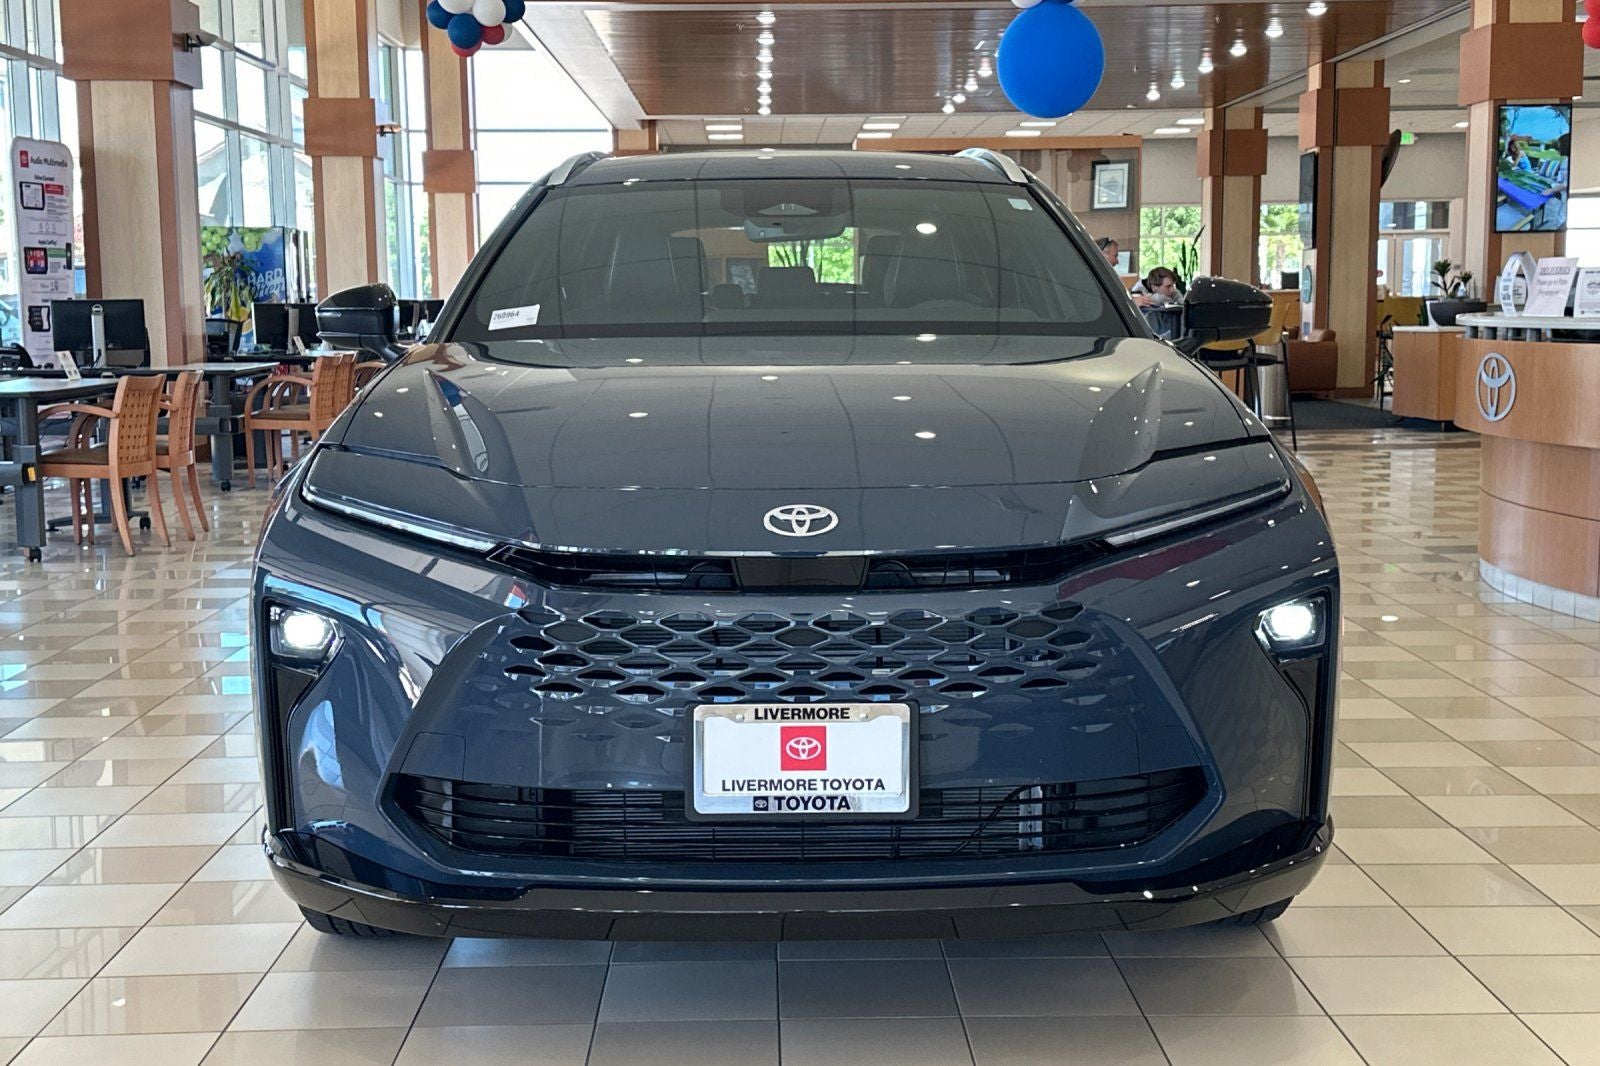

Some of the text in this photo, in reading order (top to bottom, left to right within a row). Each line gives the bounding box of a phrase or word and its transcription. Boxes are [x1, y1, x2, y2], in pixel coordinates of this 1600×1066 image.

[754, 707, 850, 720] LIVERMORE
[722, 778, 886, 792] LIVERMORE TOYOTA
[774, 796, 851, 811] TOYOTA
